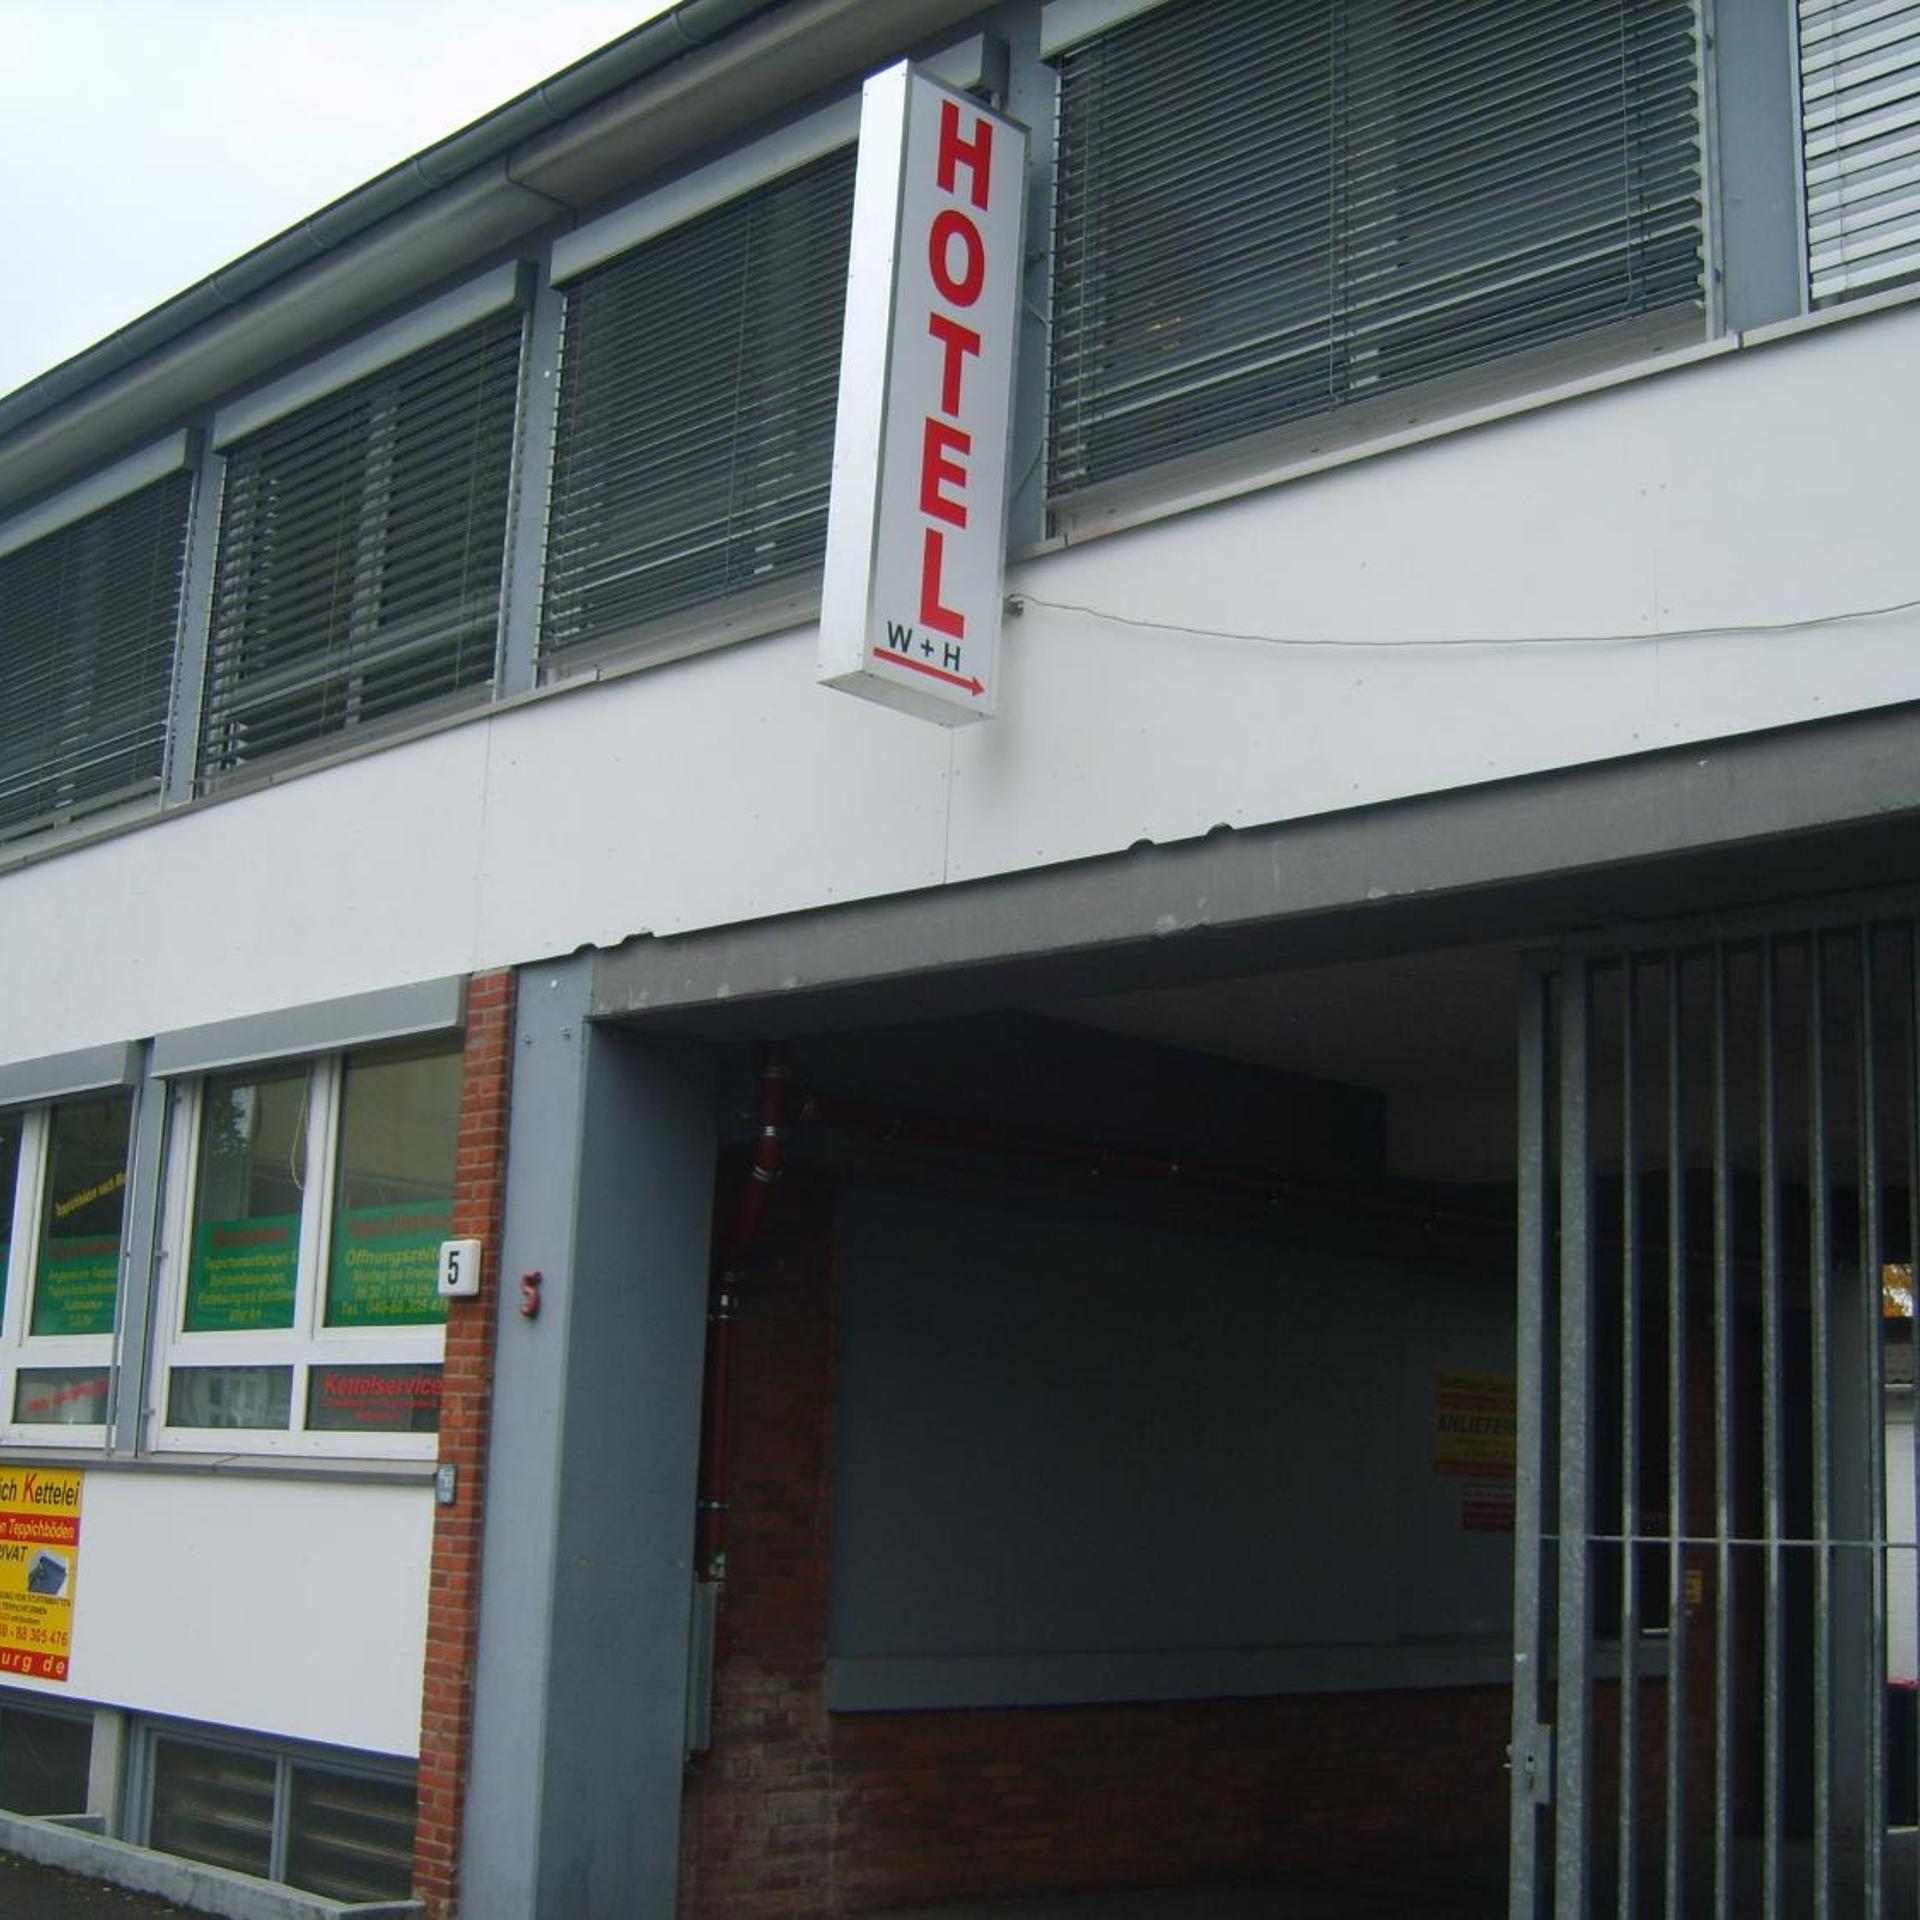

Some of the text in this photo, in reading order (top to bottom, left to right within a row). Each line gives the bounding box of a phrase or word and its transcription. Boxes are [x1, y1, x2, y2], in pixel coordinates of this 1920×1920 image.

[920, 99, 994, 640] HOTEL
[887, 620, 961, 671] W + H
[447, 1250, 460, 1284] 5
[323, 1373, 444, 1396] Kettelservice
[23, 1472, 80, 1507] Kettelei
[9, 1519, 76, 1539] Teppichböden
